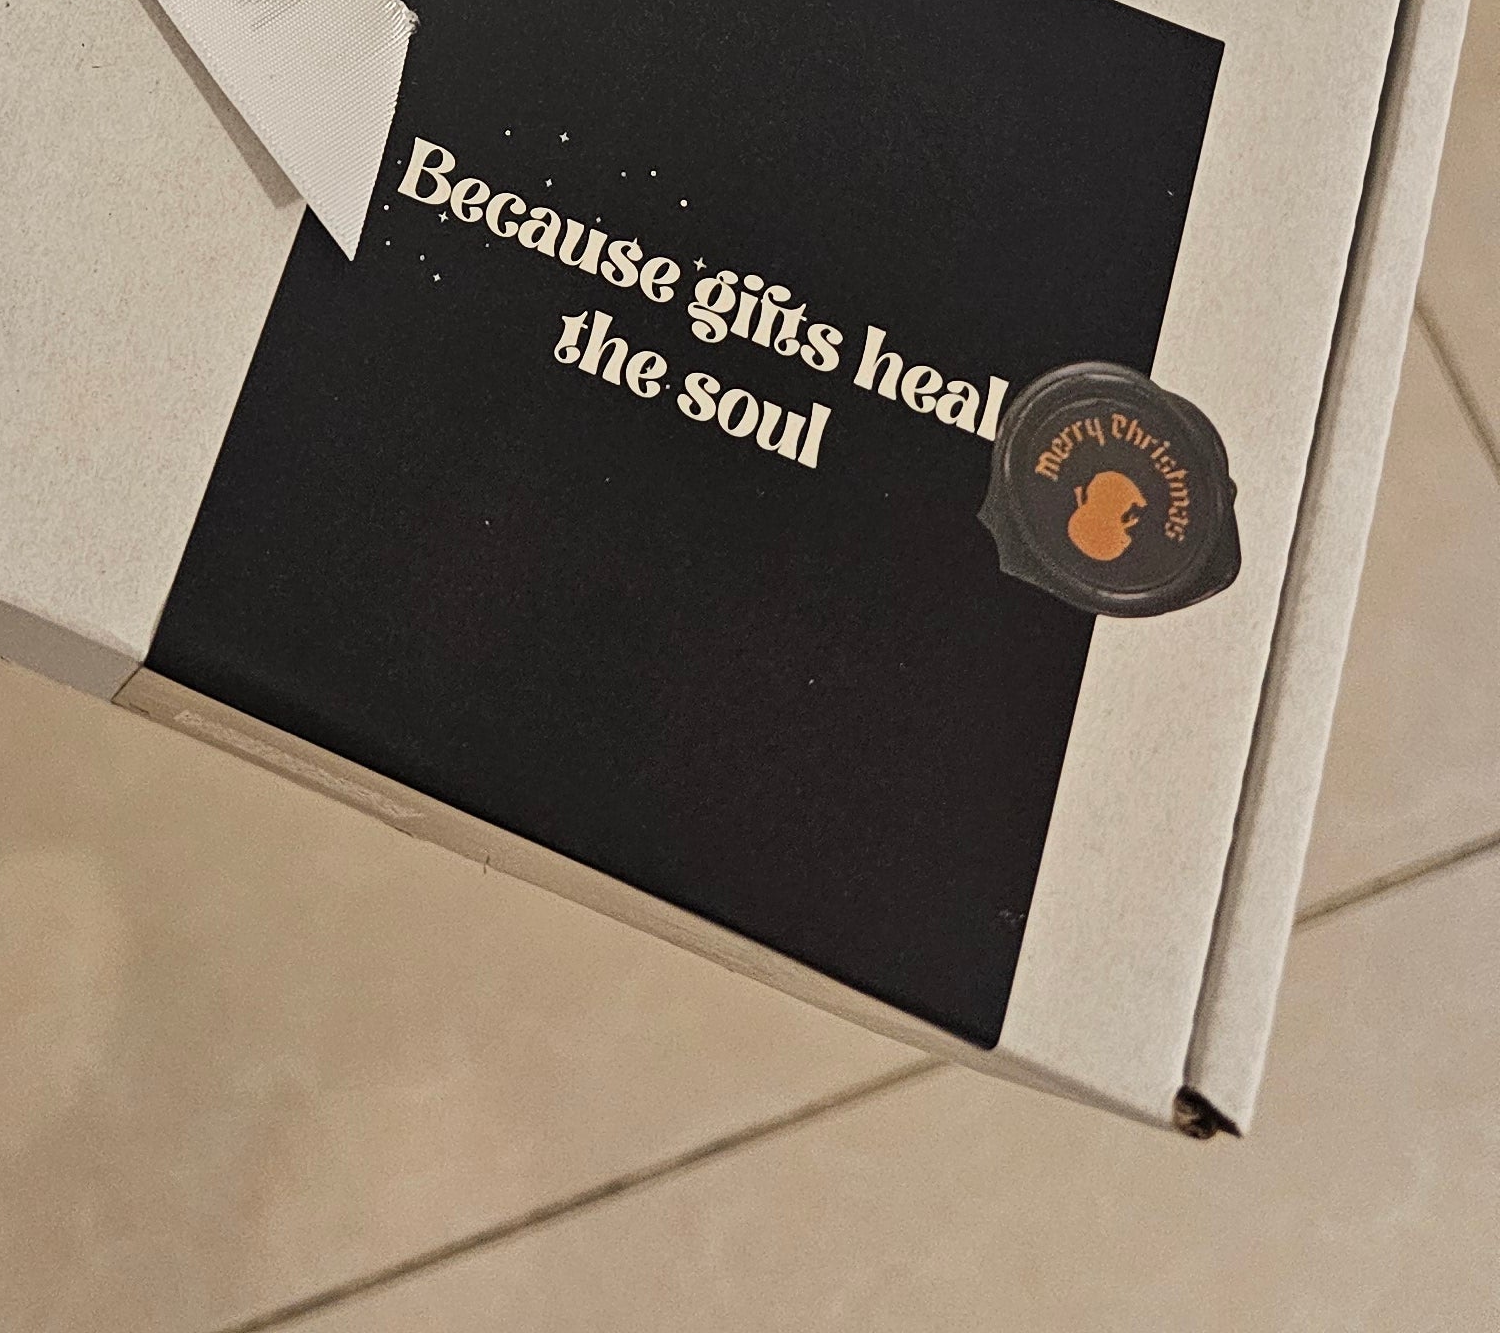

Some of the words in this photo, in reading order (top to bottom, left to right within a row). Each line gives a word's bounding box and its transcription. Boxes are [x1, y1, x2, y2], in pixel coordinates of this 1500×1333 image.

[397, 136, 681, 303] Because
[687, 270, 845, 373] gifts
[853, 325, 1010, 442] heal
[553, 310, 668, 399] the
[676, 372, 832, 470] soul
